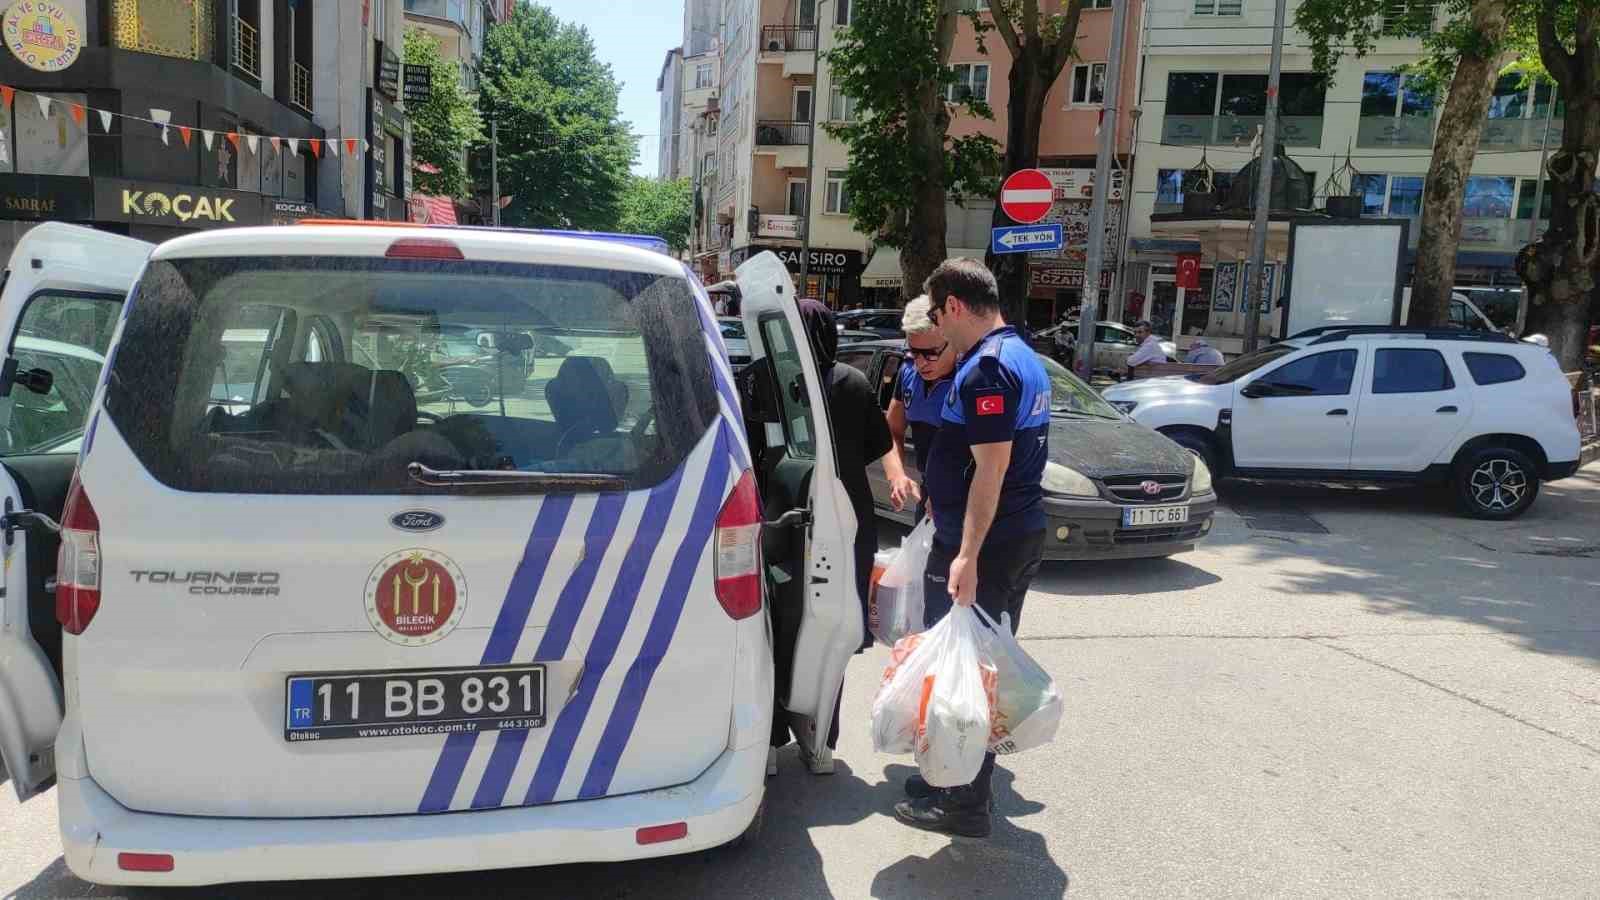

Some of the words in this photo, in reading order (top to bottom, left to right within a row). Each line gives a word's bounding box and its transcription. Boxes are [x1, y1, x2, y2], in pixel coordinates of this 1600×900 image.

[122, 189, 235, 222] KOÇAK
[1012, 232, 1031, 244] TEK
[1034, 230, 1053, 241] YÖN
[1132, 510, 1144, 522] 11
[1149, 509, 1165, 522] TC
[1168, 507, 1187, 520] 661
[129, 570, 280, 584] TOURNEO
[189, 586, 280, 596] COURIER
[396, 613, 435, 625] BİLECİK
[317, 681, 360, 721] 11
[384, 678, 446, 718] BB
[460, 673, 532, 715] 831
[293, 708, 311, 720] TR
[358, 722, 478, 738] www.otokoc.com.tr
